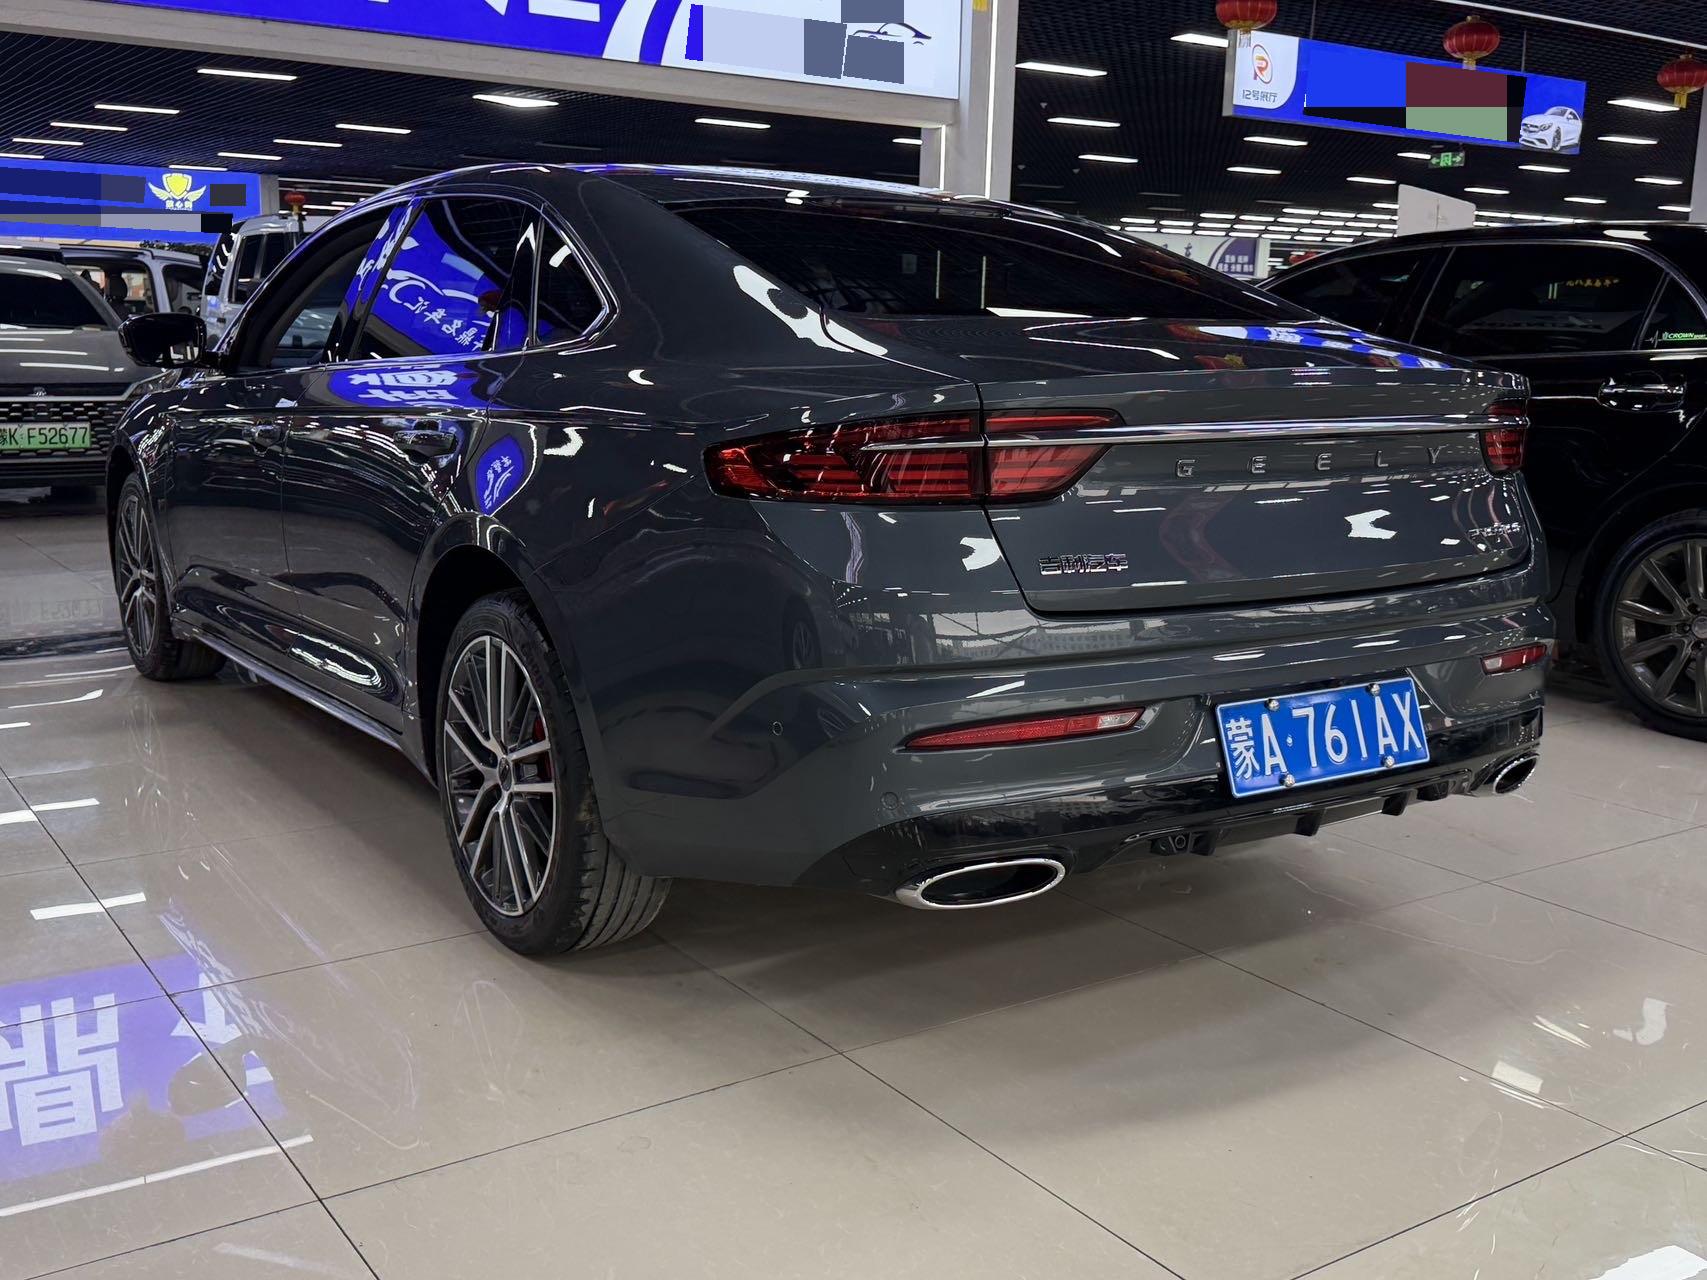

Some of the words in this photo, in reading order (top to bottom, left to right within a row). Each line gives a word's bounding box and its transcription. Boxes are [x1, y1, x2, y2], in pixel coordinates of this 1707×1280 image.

[1176, 445, 1449, 478] GEELY
[1039, 553, 1129, 576] 吉利汽车
